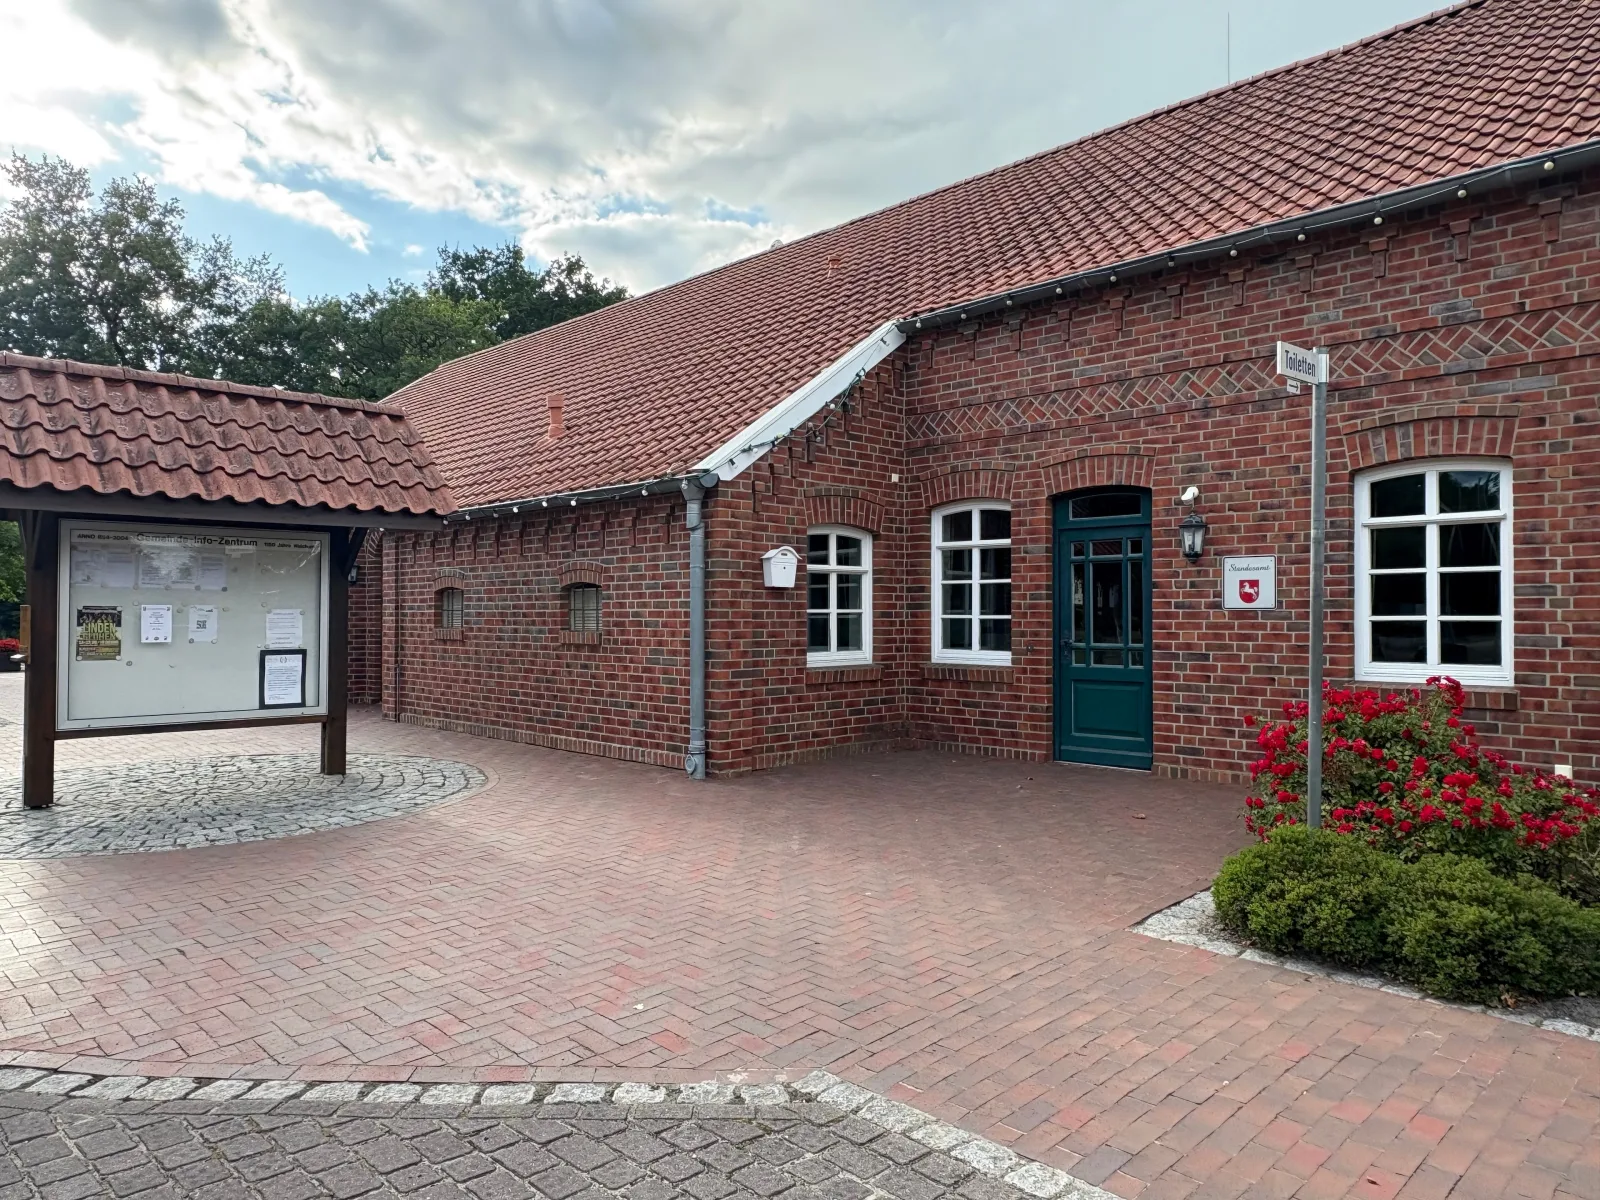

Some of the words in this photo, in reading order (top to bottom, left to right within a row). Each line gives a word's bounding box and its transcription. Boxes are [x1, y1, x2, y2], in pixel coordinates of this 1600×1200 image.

[1284, 349, 1316, 377] Toiletten
[136, 533, 258, 547] Gemeinde-Info-Zentrum
[1228, 563, 1271, 573] Standesamt
[83, 622, 116, 633] LINDEN
